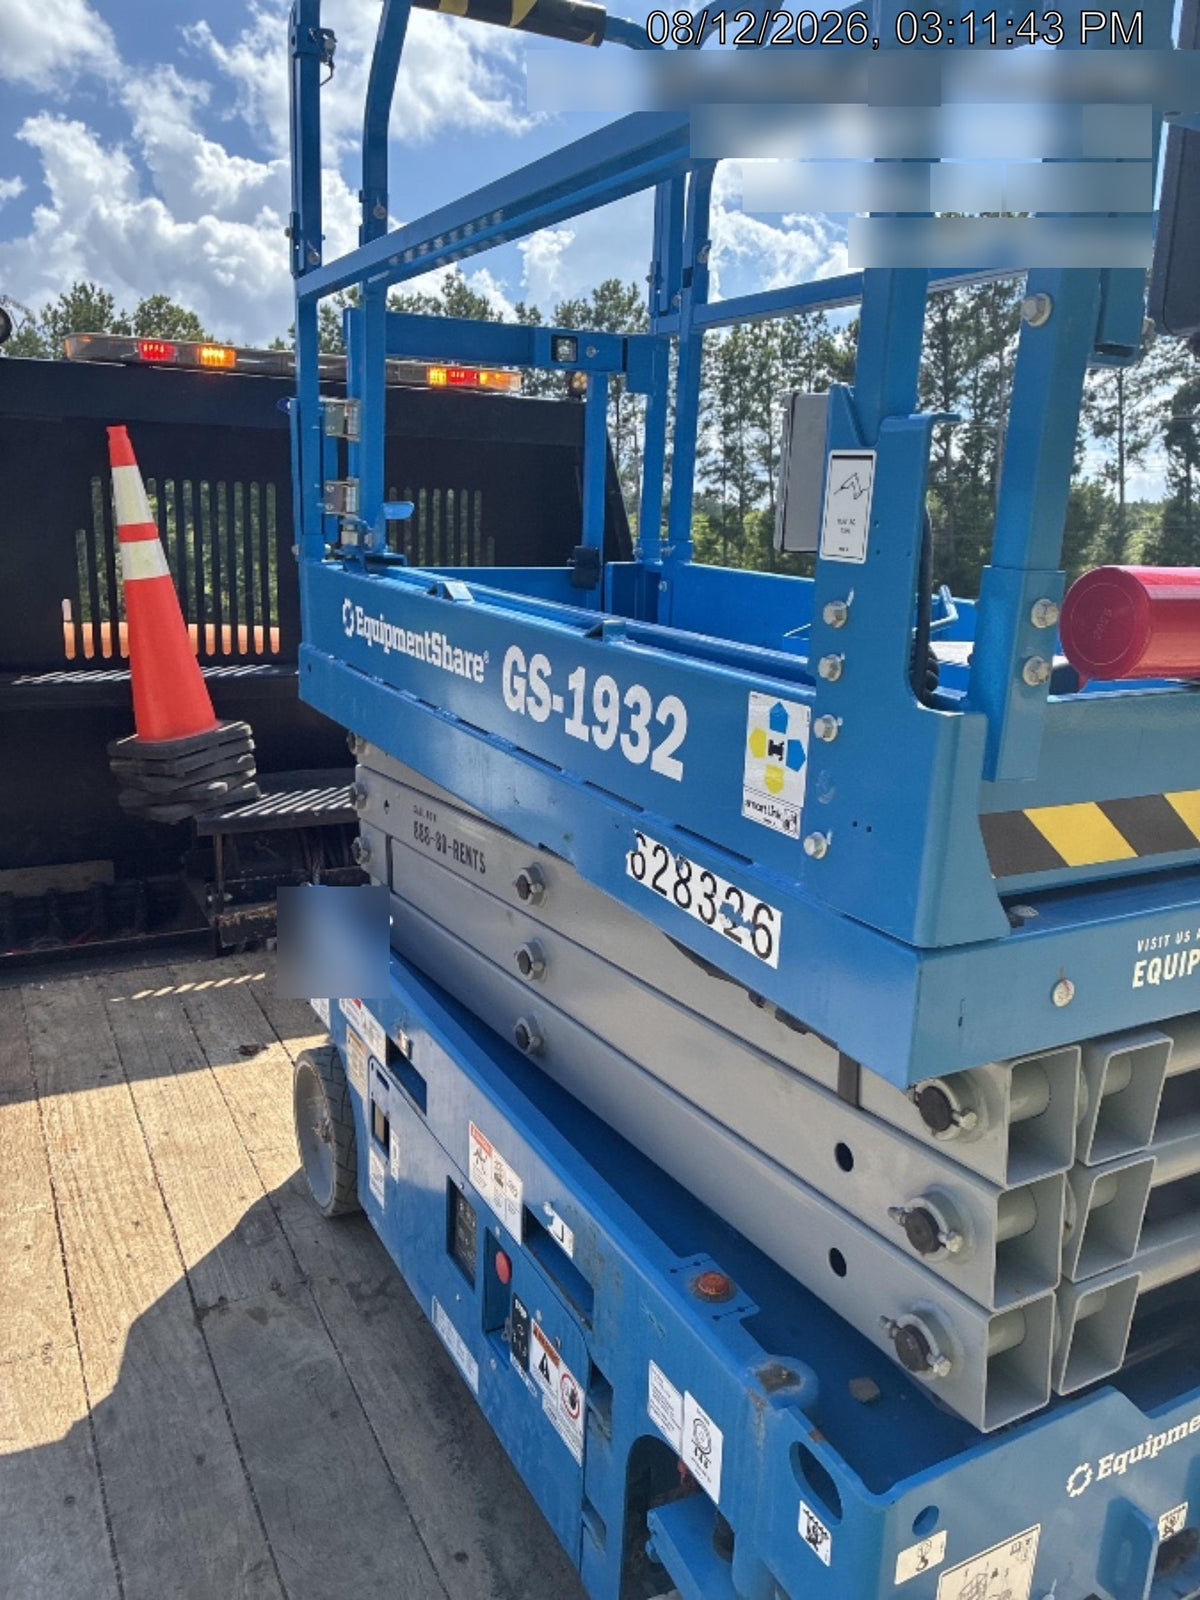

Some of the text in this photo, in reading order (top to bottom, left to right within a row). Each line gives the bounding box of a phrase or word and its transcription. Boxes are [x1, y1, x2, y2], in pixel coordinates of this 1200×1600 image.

[503, 645, 688, 782] GS-1932
[630, 832, 774, 960] 628326
[1137, 934, 1171, 953] VISIT
[1175, 930, 1191, 945] US
